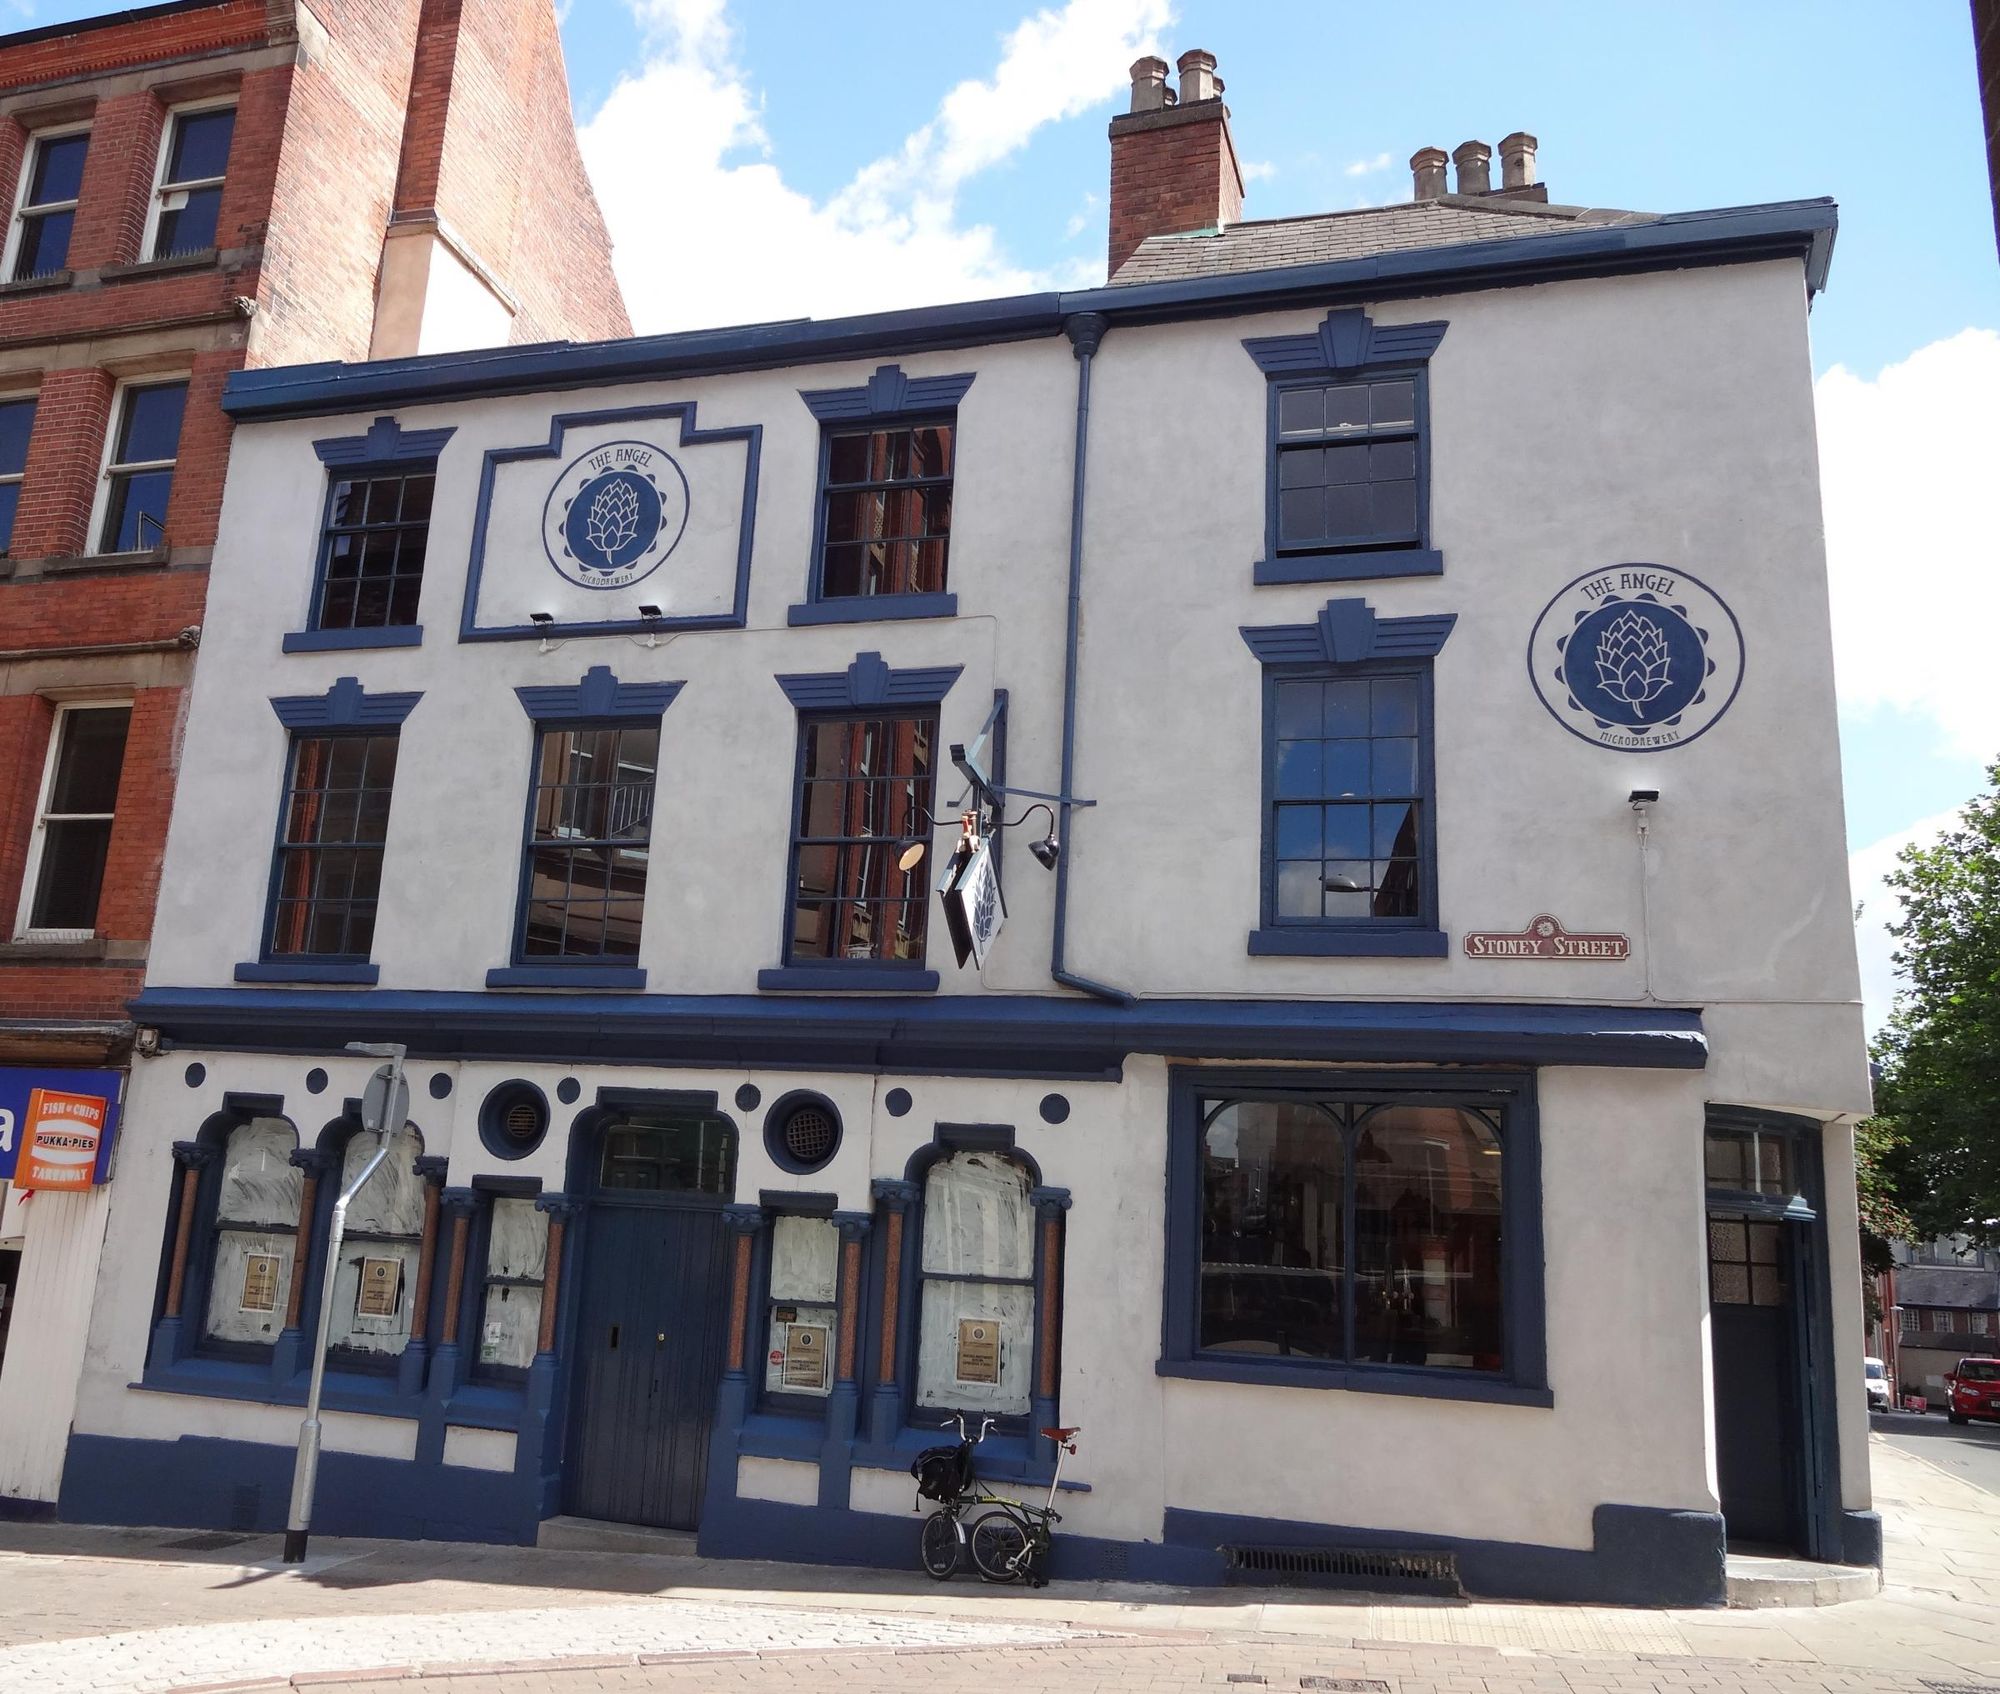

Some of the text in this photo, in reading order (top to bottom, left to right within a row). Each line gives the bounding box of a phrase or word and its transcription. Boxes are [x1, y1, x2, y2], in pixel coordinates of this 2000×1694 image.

[588, 448, 652, 470] THE ANGEL
[580, 572, 633, 586] MICROBREWERY
[1580, 573, 1676, 600] THE ANGEL
[1599, 730, 1681, 747] MICROBREWERY
[1473, 936, 1624, 956] STONEY STREET
[42, 1102, 66, 1115] FISH
[73, 1104, 100, 1120] CHIPS
